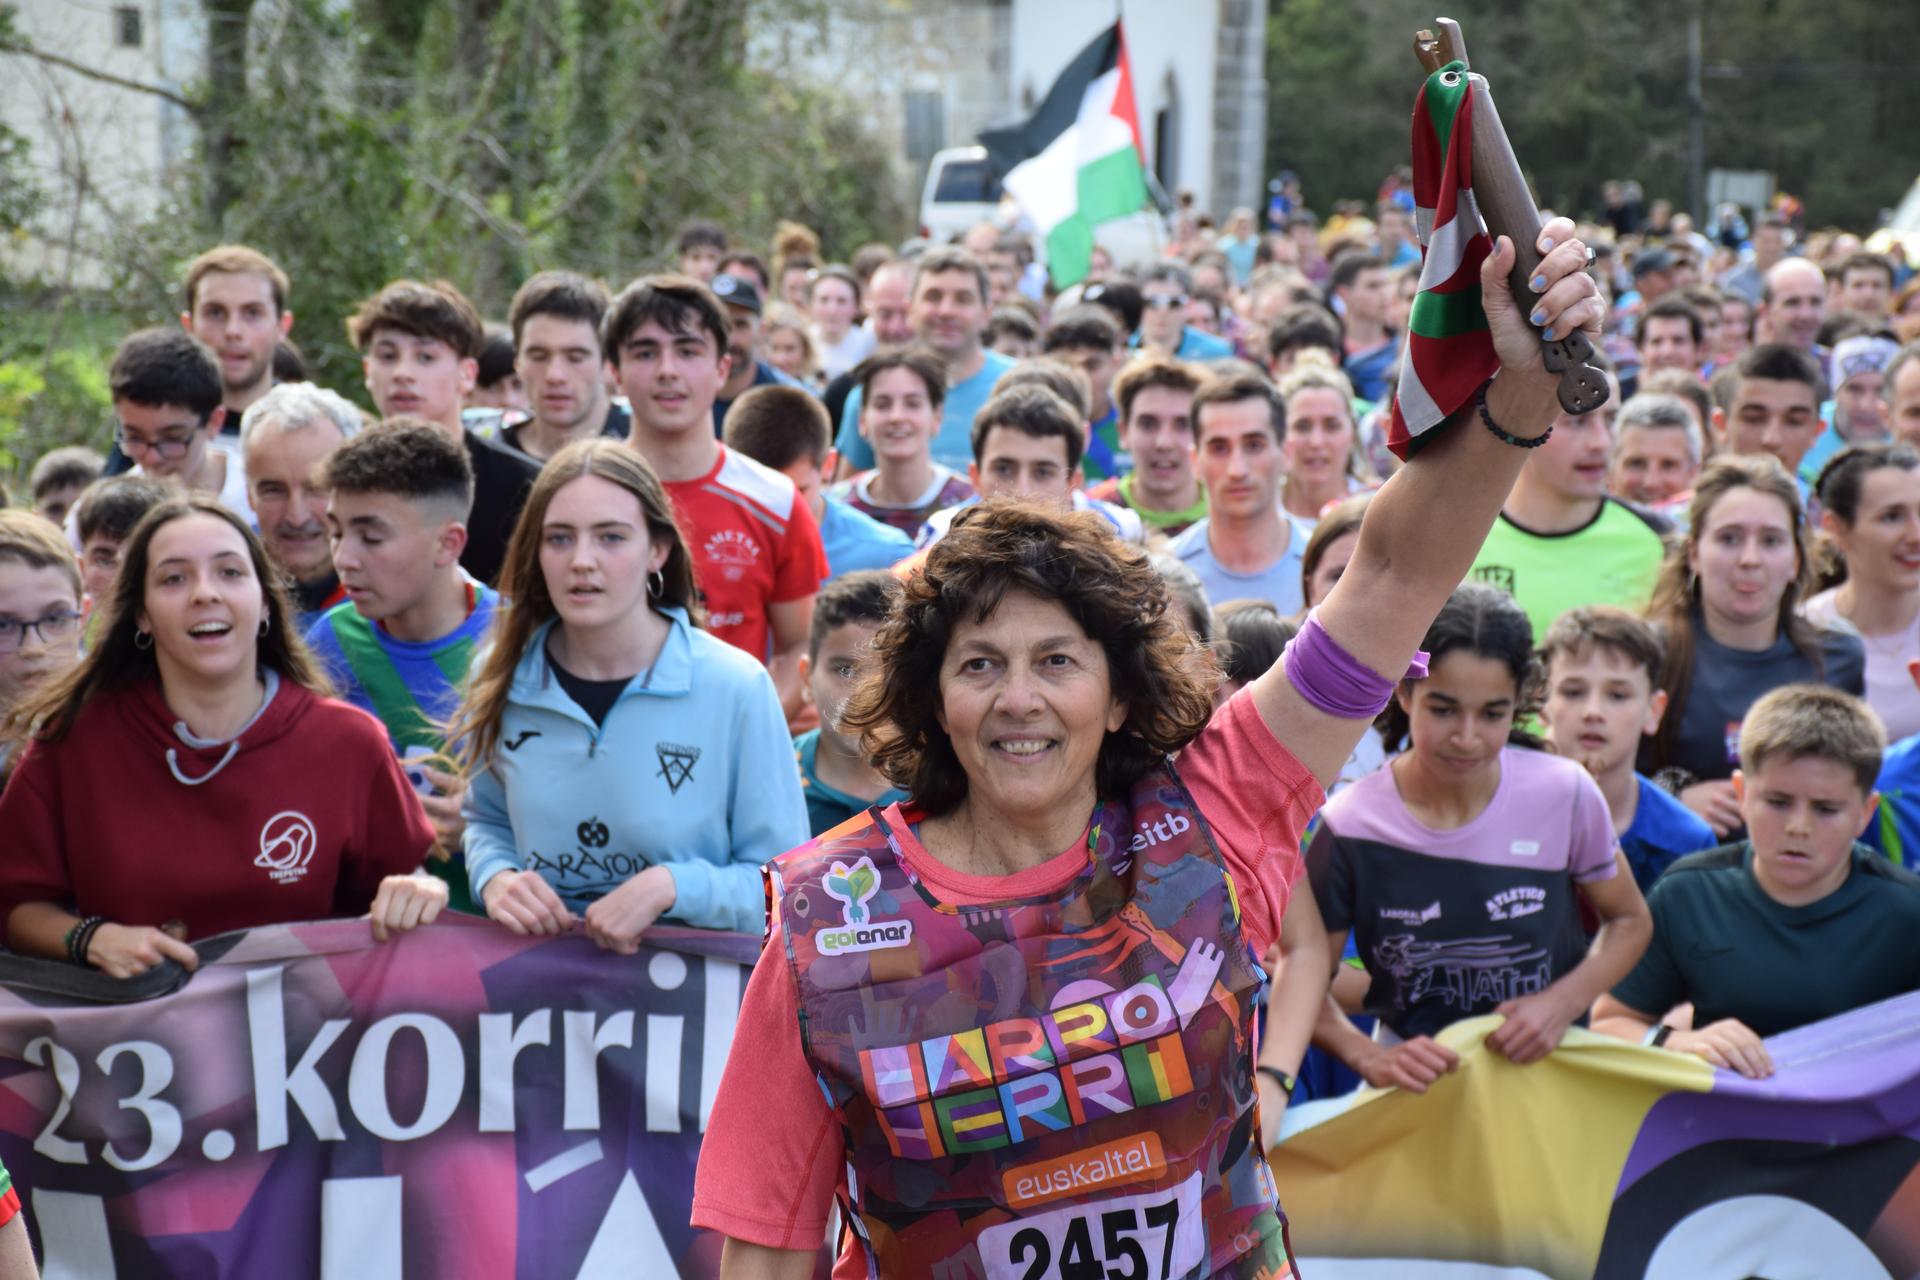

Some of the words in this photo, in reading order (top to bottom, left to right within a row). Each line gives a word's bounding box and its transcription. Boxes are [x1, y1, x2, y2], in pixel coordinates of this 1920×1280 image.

[1132, 813, 1190, 851] eitb
[822, 925, 907, 949] goiener
[859, 976, 1180, 1108] HARRO
[876, 1033, 1194, 1160] HERRI
[1015, 1141, 1151, 1200] euskaltel
[1009, 1198, 1180, 1280] 2457
